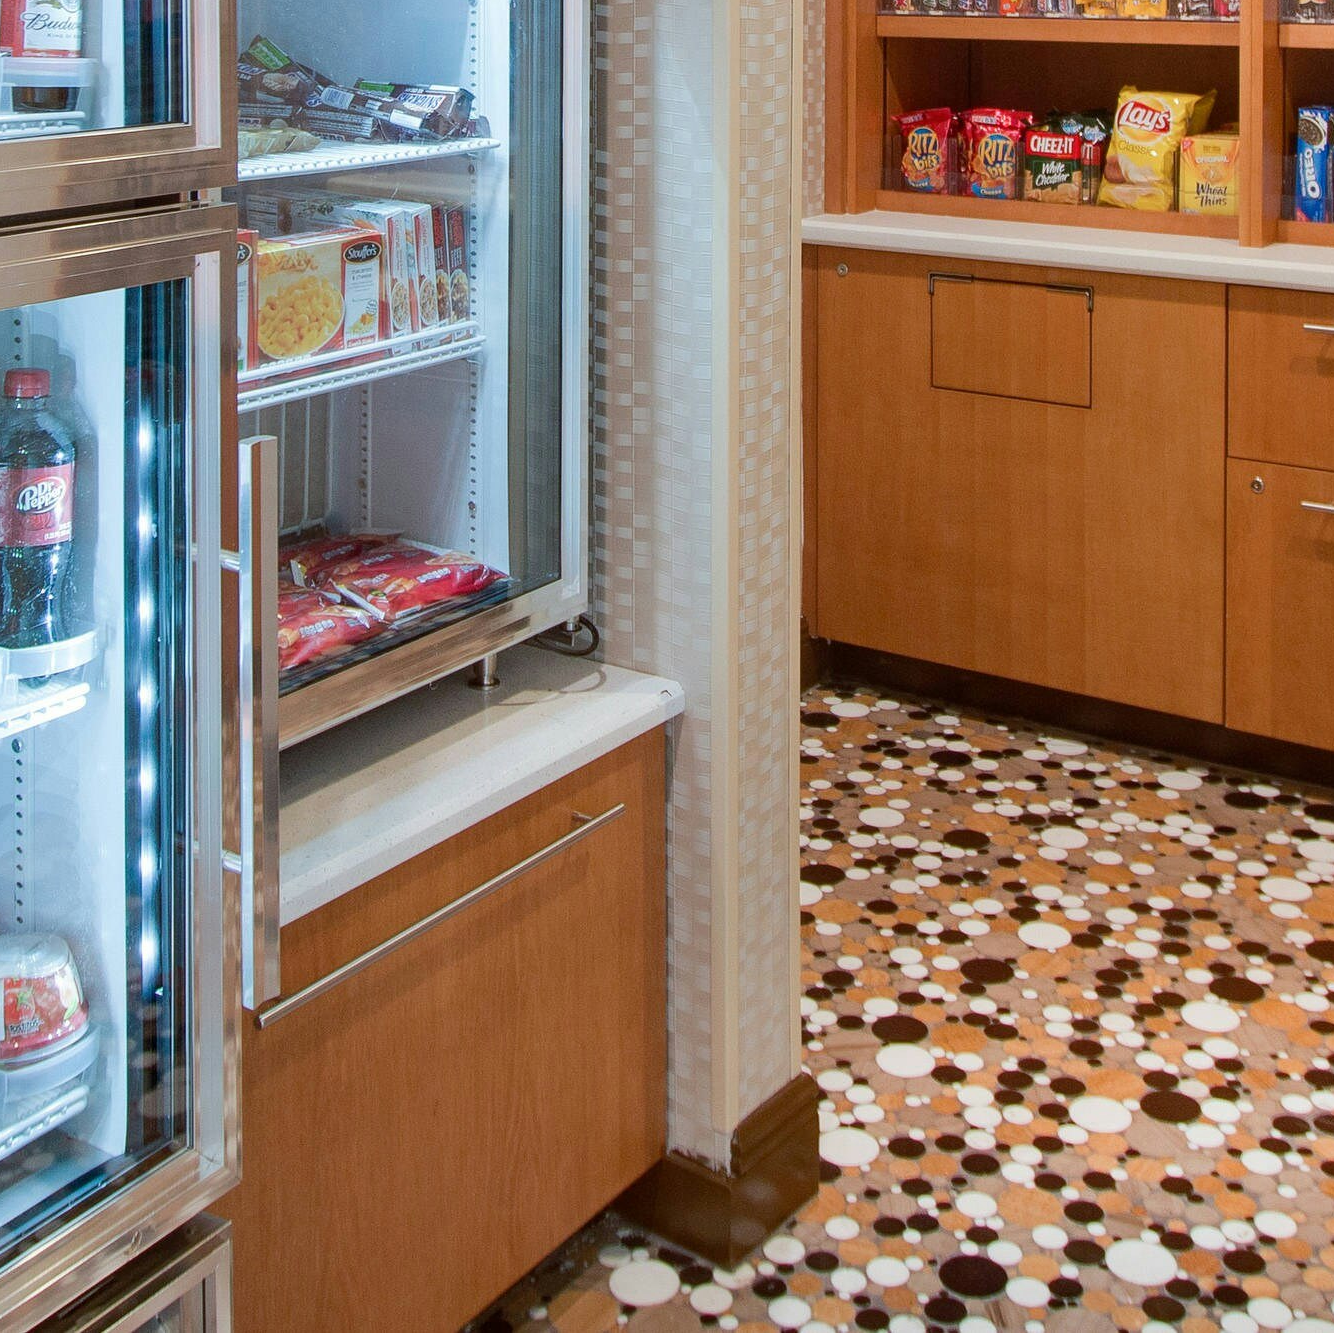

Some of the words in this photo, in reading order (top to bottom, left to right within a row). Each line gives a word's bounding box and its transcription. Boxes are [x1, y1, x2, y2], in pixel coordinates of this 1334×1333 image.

[1119, 101, 1171, 132] Lay's
[908, 132, 939, 155] RITZ
[979, 139, 1015, 166] RITZ
[1029, 134, 1075, 155] CHEEZ-IT
[1118, 139, 1150, 155] Class
[1304, 148, 1321, 199] OREO
[1196, 182, 1228, 196] Wheat
[1195, 195, 1227, 207] Thins
[347, 244, 379, 260] Stouffer's
[23, 485, 64, 512] Pepper
[36, 481, 54, 495] Dr
